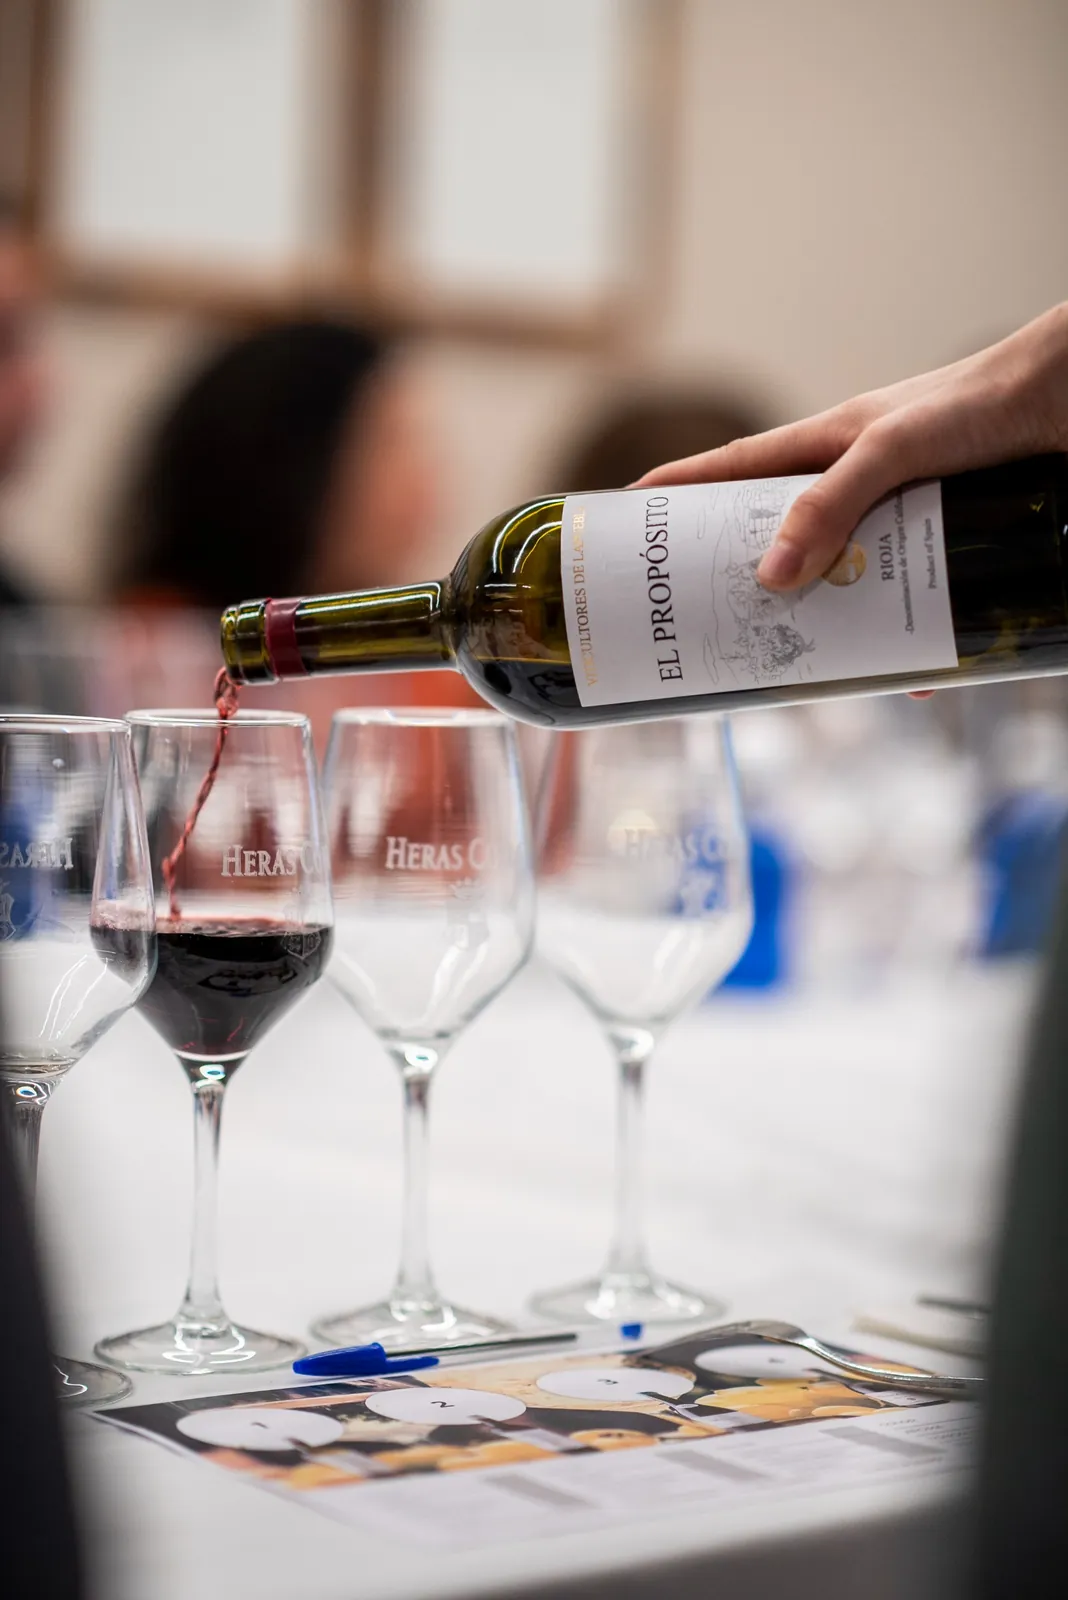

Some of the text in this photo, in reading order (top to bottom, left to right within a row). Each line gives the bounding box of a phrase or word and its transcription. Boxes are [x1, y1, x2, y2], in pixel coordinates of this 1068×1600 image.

[895, 525, 907, 556] Origen
[924, 517, 937, 589] Product of Spain
[879, 532, 895, 581] RIOJA
[898, 557, 907, 568] de
[573, 565, 585, 583] DE
[639, 496, 684, 683] EL PROPÓSITO
[431, 1400, 455, 1408] 2
